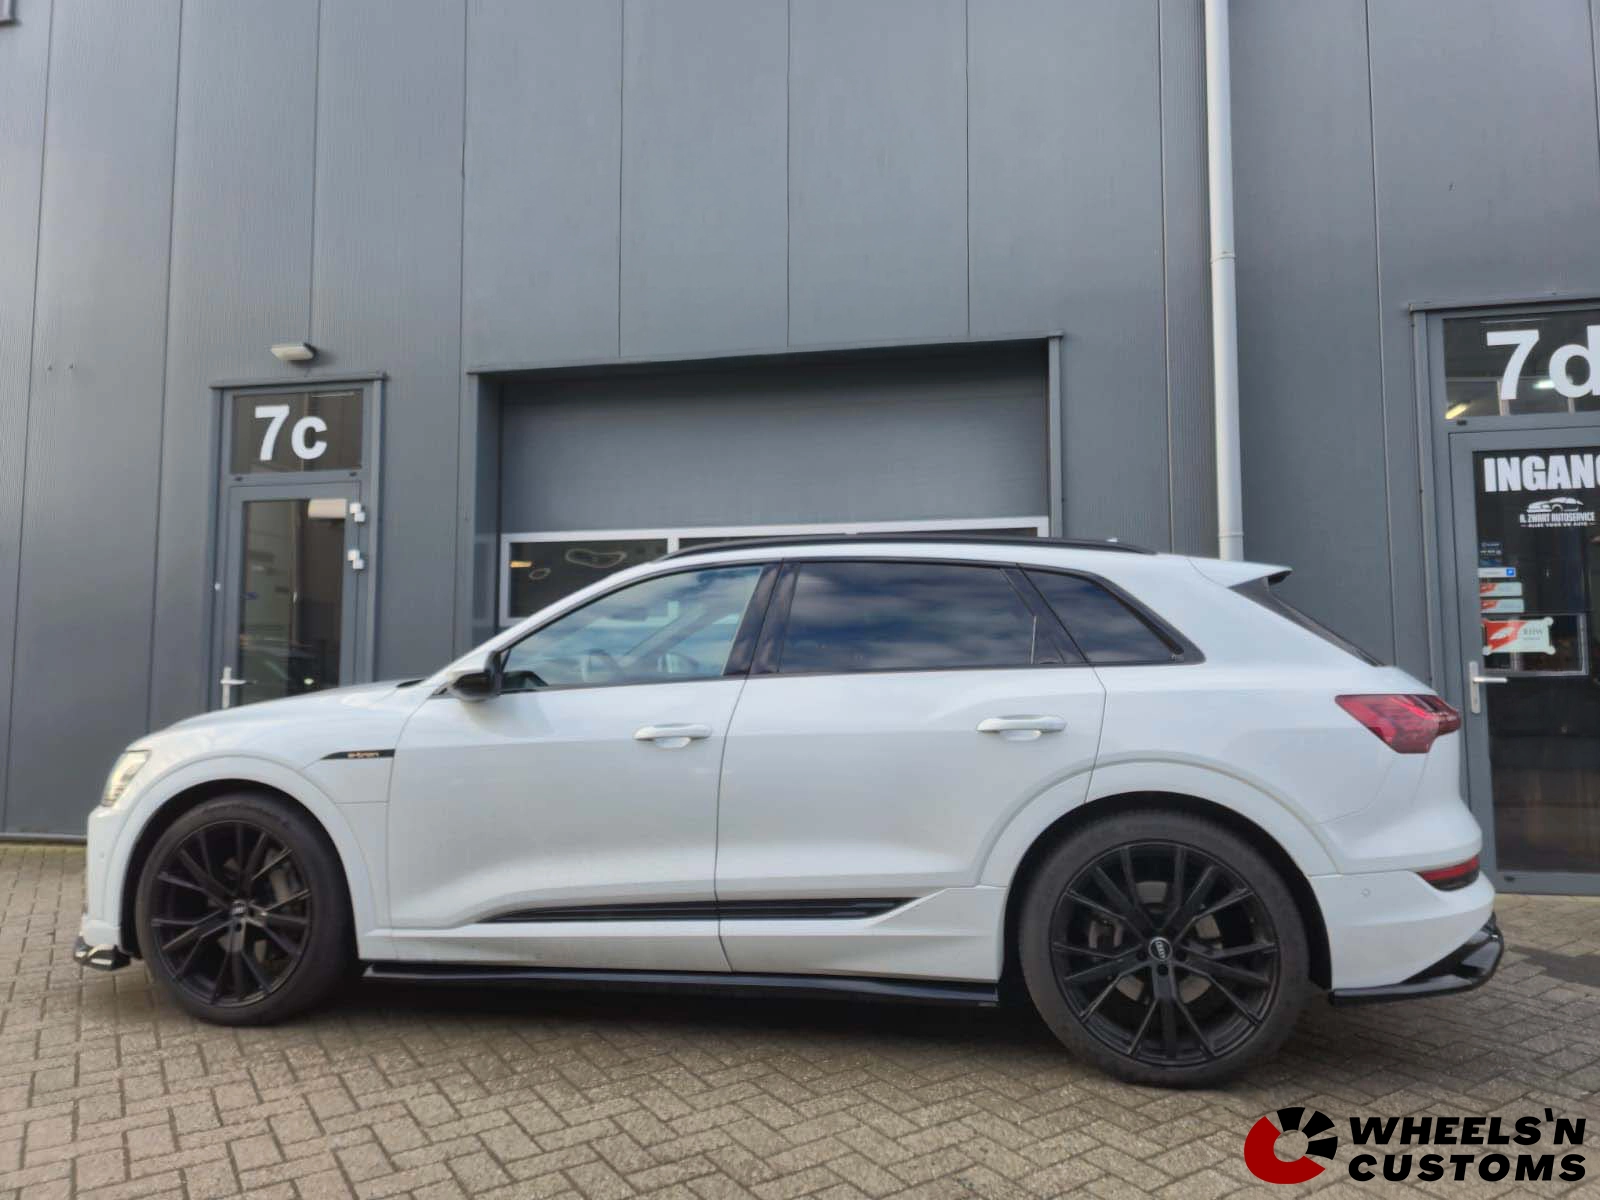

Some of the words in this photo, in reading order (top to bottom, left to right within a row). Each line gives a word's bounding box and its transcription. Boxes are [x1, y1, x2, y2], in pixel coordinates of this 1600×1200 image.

[1486, 325, 1600, 400] 7d
[255, 404, 328, 461] 7c
[1484, 453, 1600, 492] INGAN
[1551, 511, 1595, 522] AUTOSERVICE
